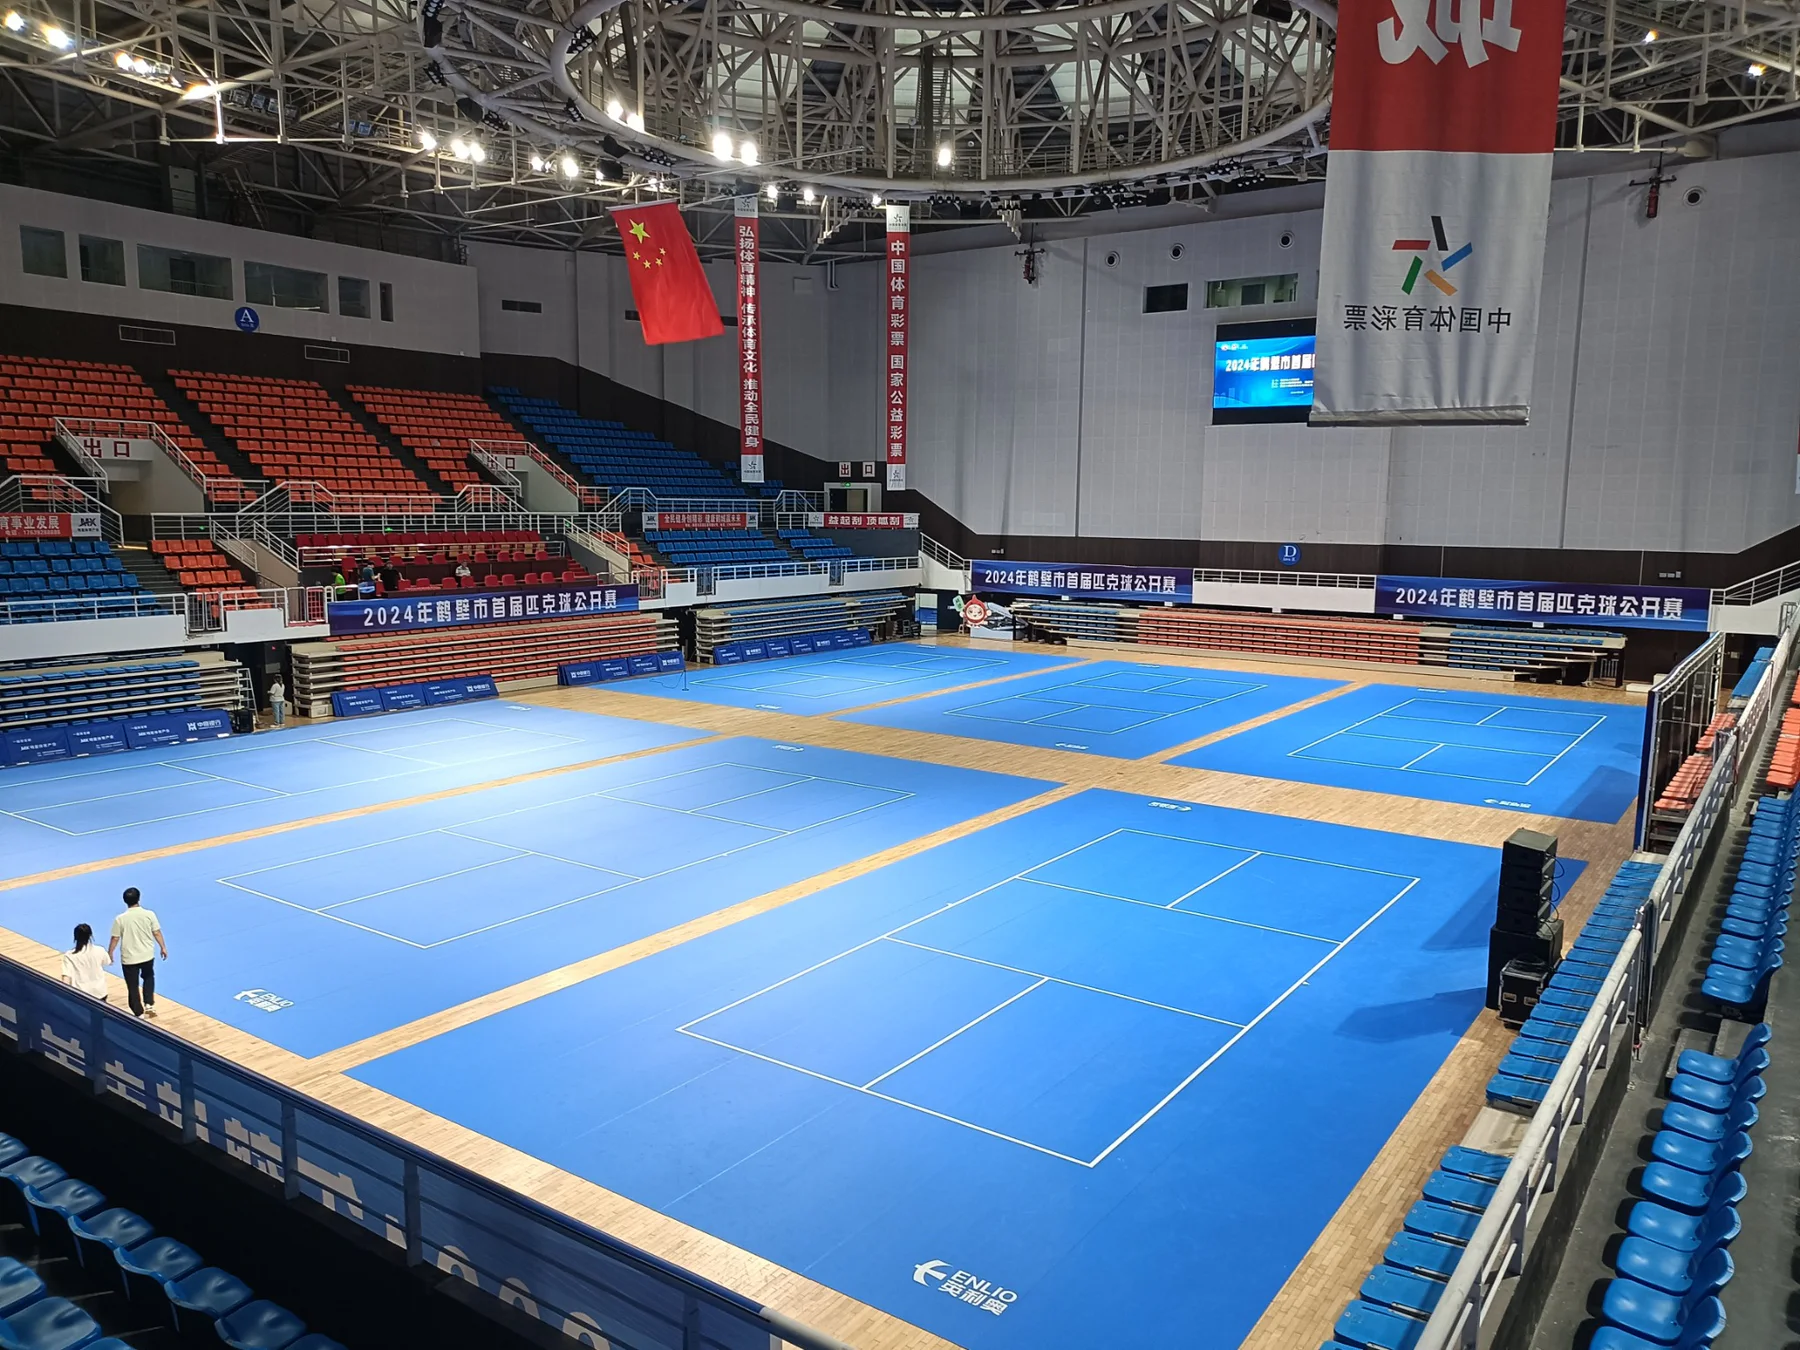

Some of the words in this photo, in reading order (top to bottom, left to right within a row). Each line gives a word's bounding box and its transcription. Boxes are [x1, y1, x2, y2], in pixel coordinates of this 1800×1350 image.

[739, 225, 756, 298] 弘扬体育精神
[890, 239, 906, 346] 中国体育彩票
[240, 308, 255, 323] A
[741, 302, 758, 373] 传承体育文化
[1225, 353, 1316, 372] 2024年鹤壁市首届
[743, 378, 760, 448] 推动全民健身
[890, 354, 904, 458] 国家公益彩票
[83, 437, 130, 459] 出口
[840, 463, 873, 476] 出口
[828, 515, 863, 526] 益起刮
[1283, 545, 1297, 558] D
[985, 569, 1176, 595] 2024年鹤壁市首届匹克球公开赛
[363, 588, 617, 627] 2024年鹤壁市首届匹克球公开赛
[1395, 587, 1683, 621] 2024年鹤壁市首届匹克球公开赛
[937, 1279, 1008, 1316] 英利奥
[951, 1270, 1018, 1303] ENLIO
